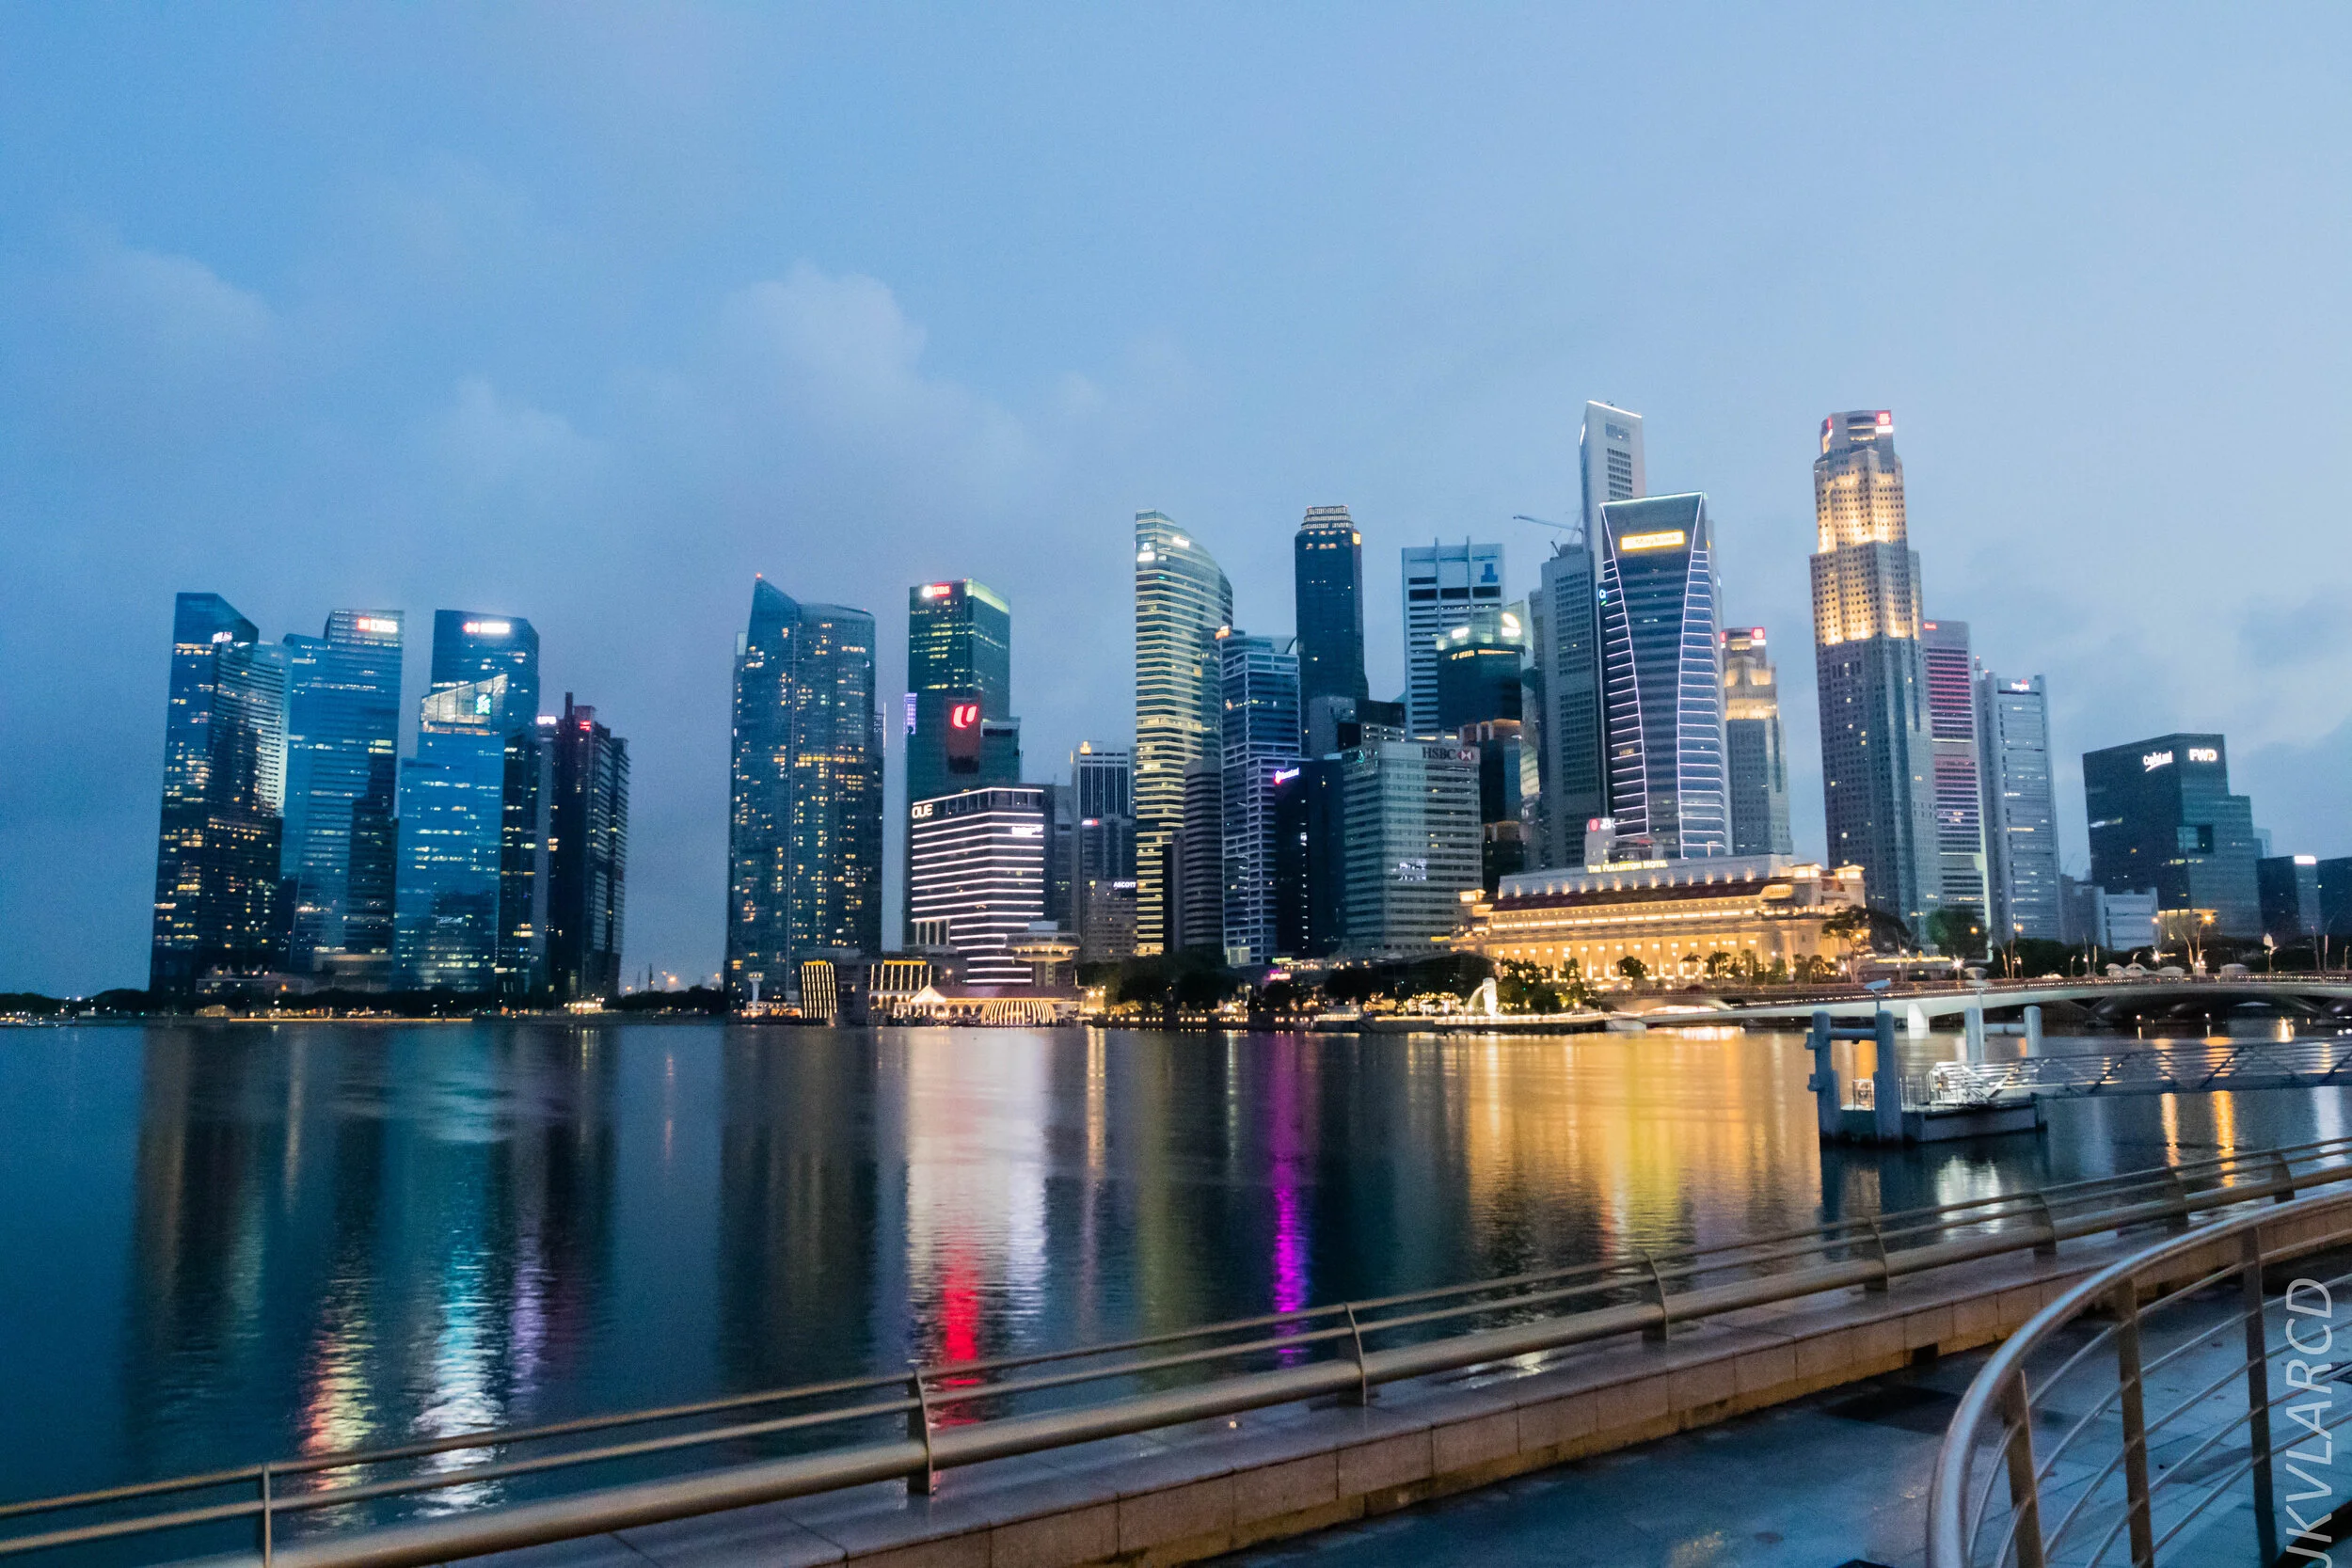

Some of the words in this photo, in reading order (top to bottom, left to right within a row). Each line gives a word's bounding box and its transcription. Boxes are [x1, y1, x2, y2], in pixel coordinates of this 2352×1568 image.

[1422, 747, 1457, 761] HSBC
[2189, 749, 2217, 761] FWD
[912, 804, 933, 819] OUE
[1113, 880, 1136, 889] ASCOTT
